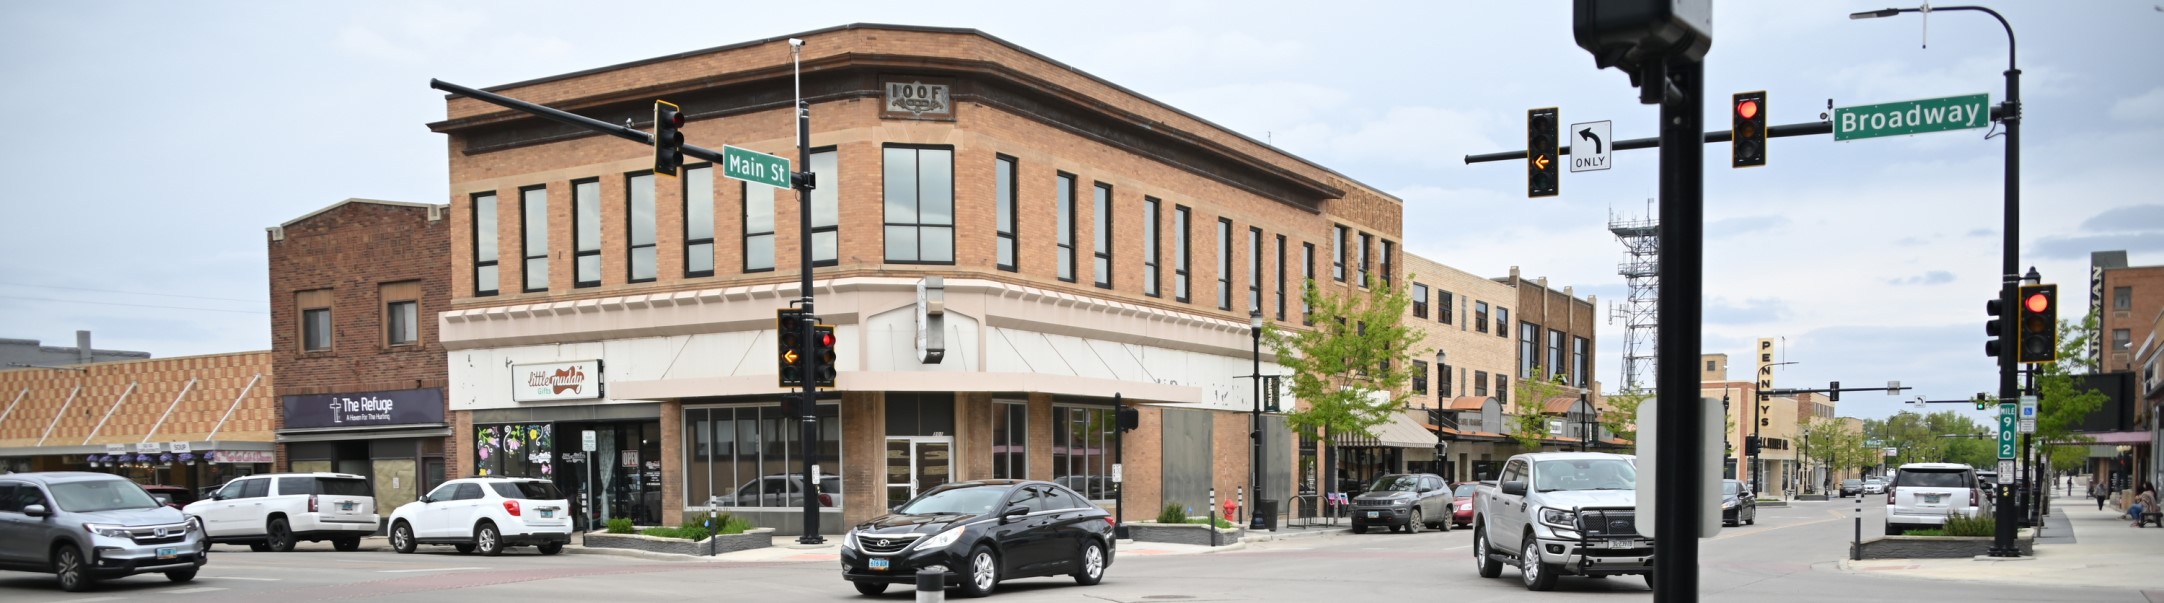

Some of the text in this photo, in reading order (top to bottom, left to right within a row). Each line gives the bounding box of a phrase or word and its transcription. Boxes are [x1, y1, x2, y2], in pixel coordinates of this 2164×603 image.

[1842, 104, 1980, 134] Broadway
[730, 154, 784, 182] Main St
[1576, 156, 1605, 168] ONLY
[528, 369, 583, 394] little muddy
[1761, 341, 1771, 426] PENNEYS
[342, 396, 393, 414] The Refuge
[2001, 407, 2015, 415] MILE
[2002, 416, 2012, 455] 902
[622, 451, 638, 466] OPEN
